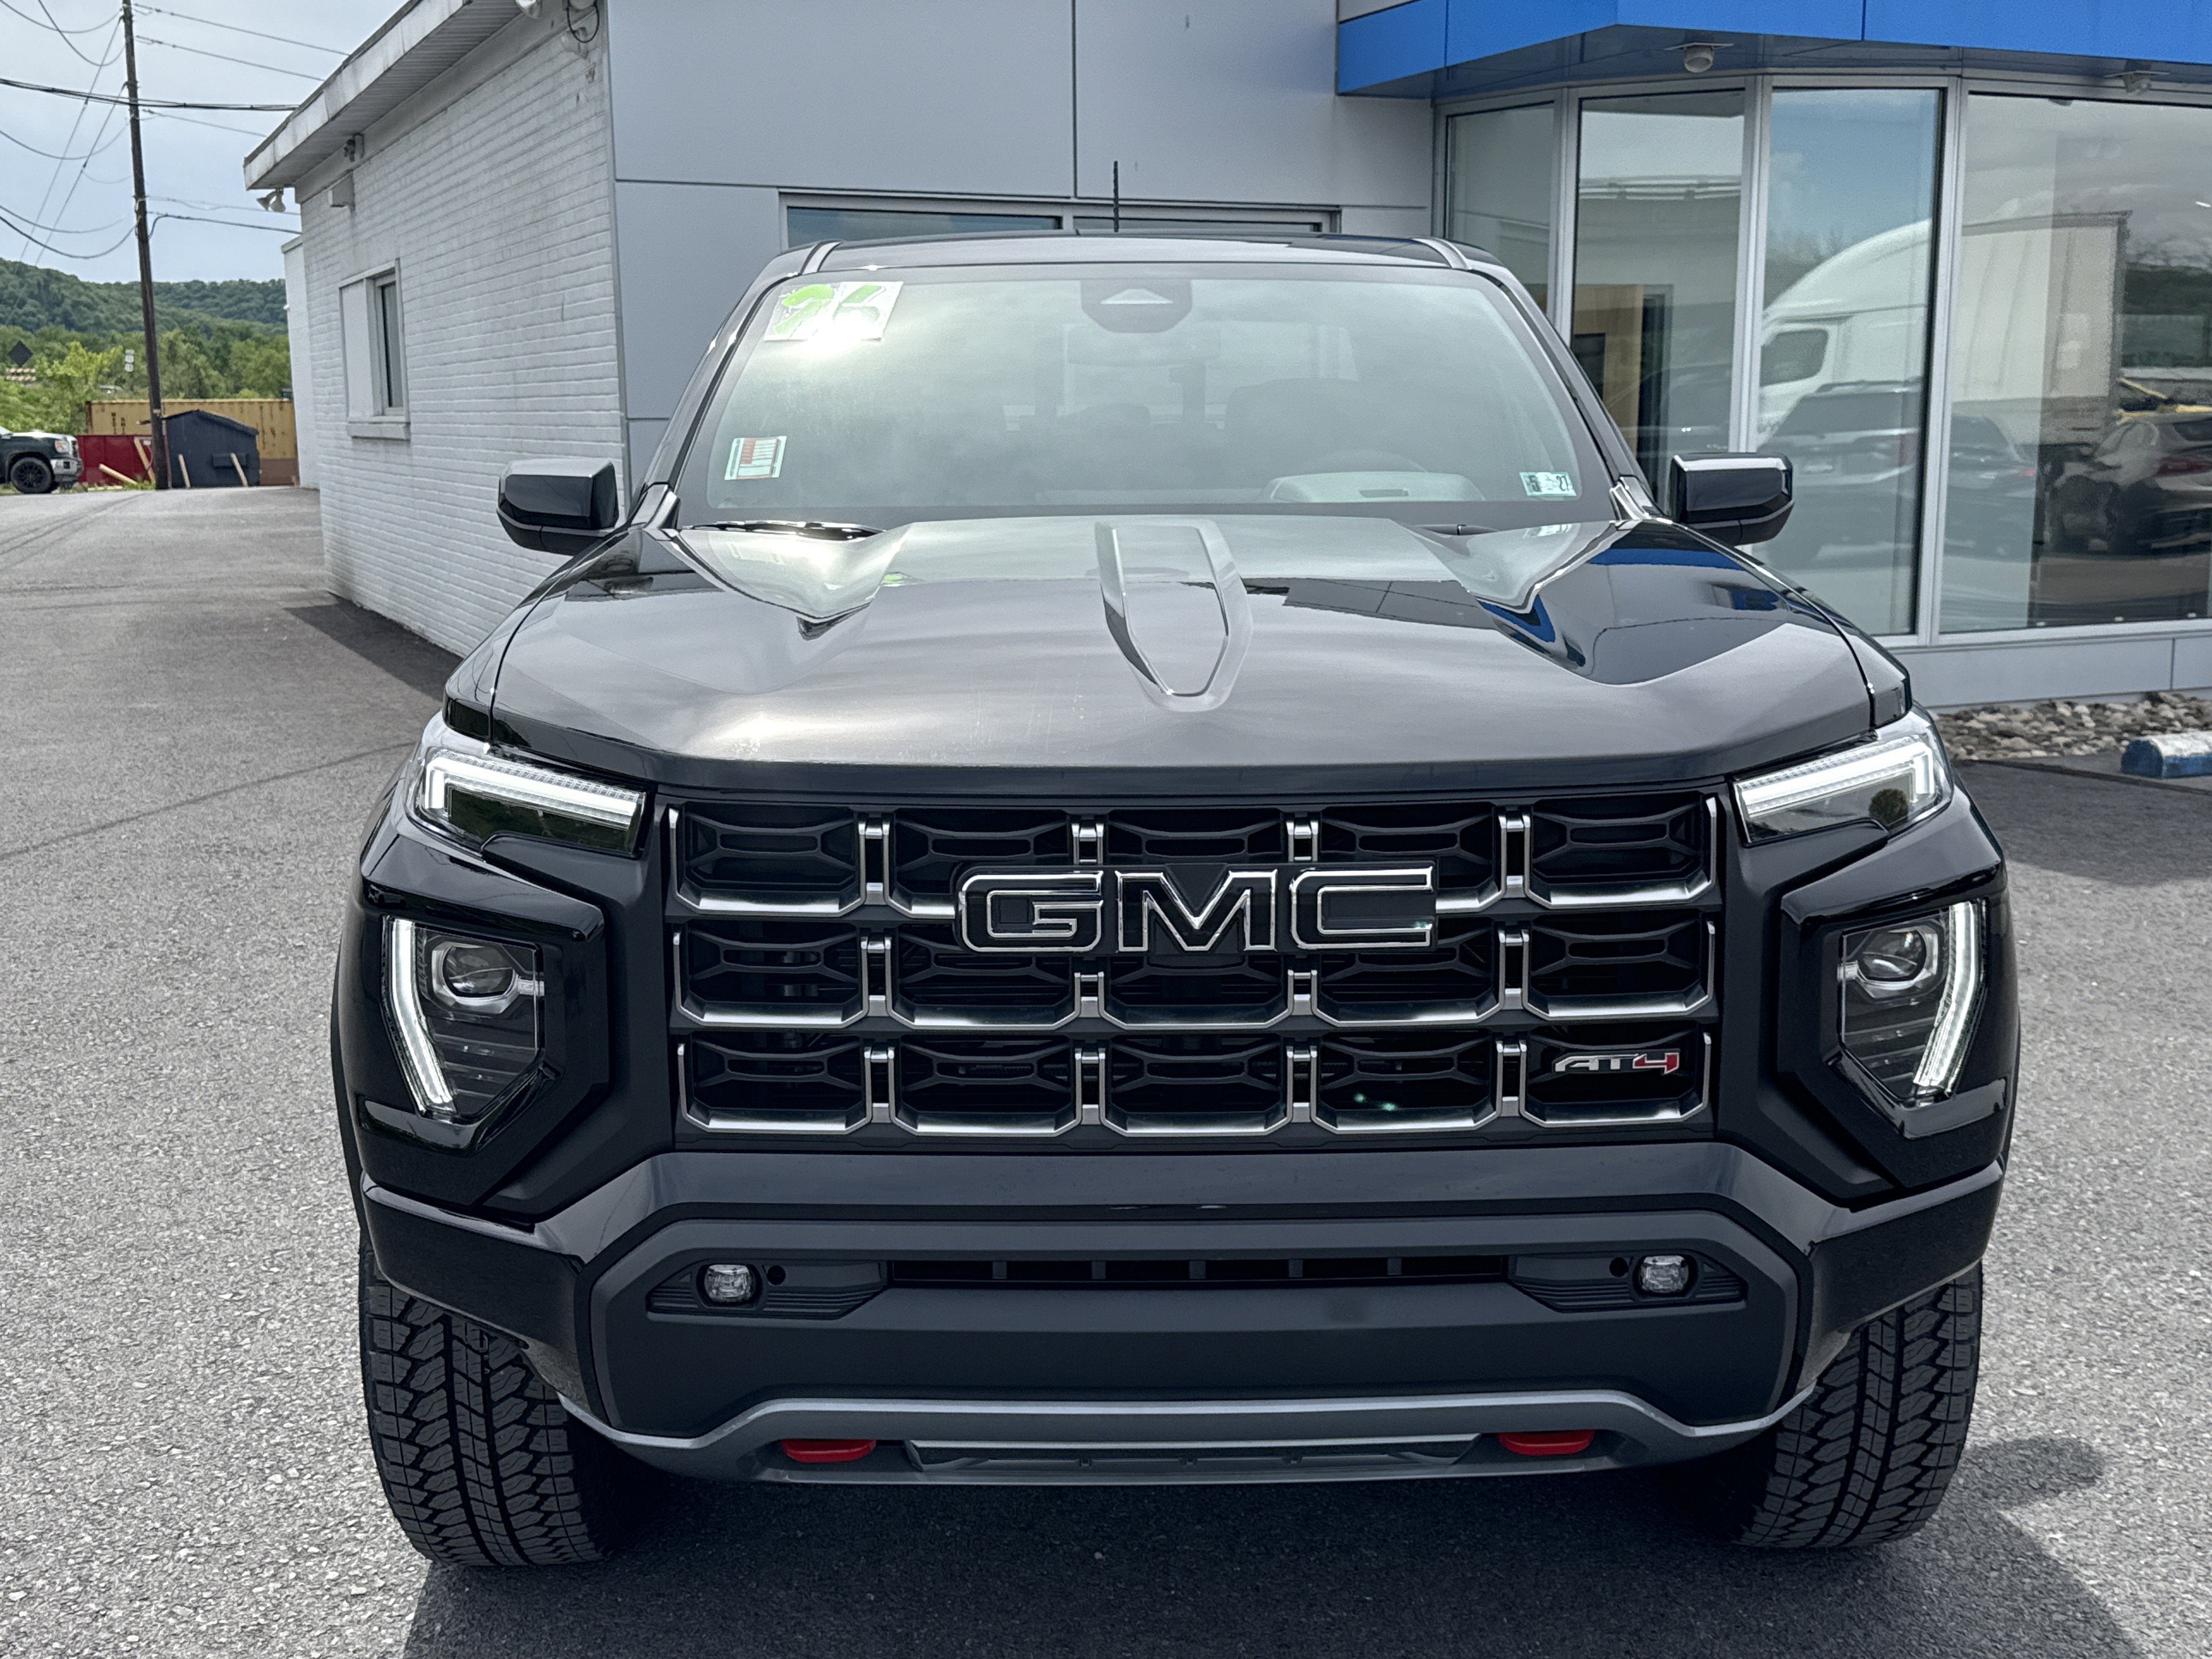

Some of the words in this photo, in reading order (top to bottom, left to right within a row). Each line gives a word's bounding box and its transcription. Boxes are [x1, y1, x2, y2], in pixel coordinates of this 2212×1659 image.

[1528, 475, 1542, 493] 5
[958, 868, 1434, 952] GMC
[1555, 1052, 1680, 1075] AT4
